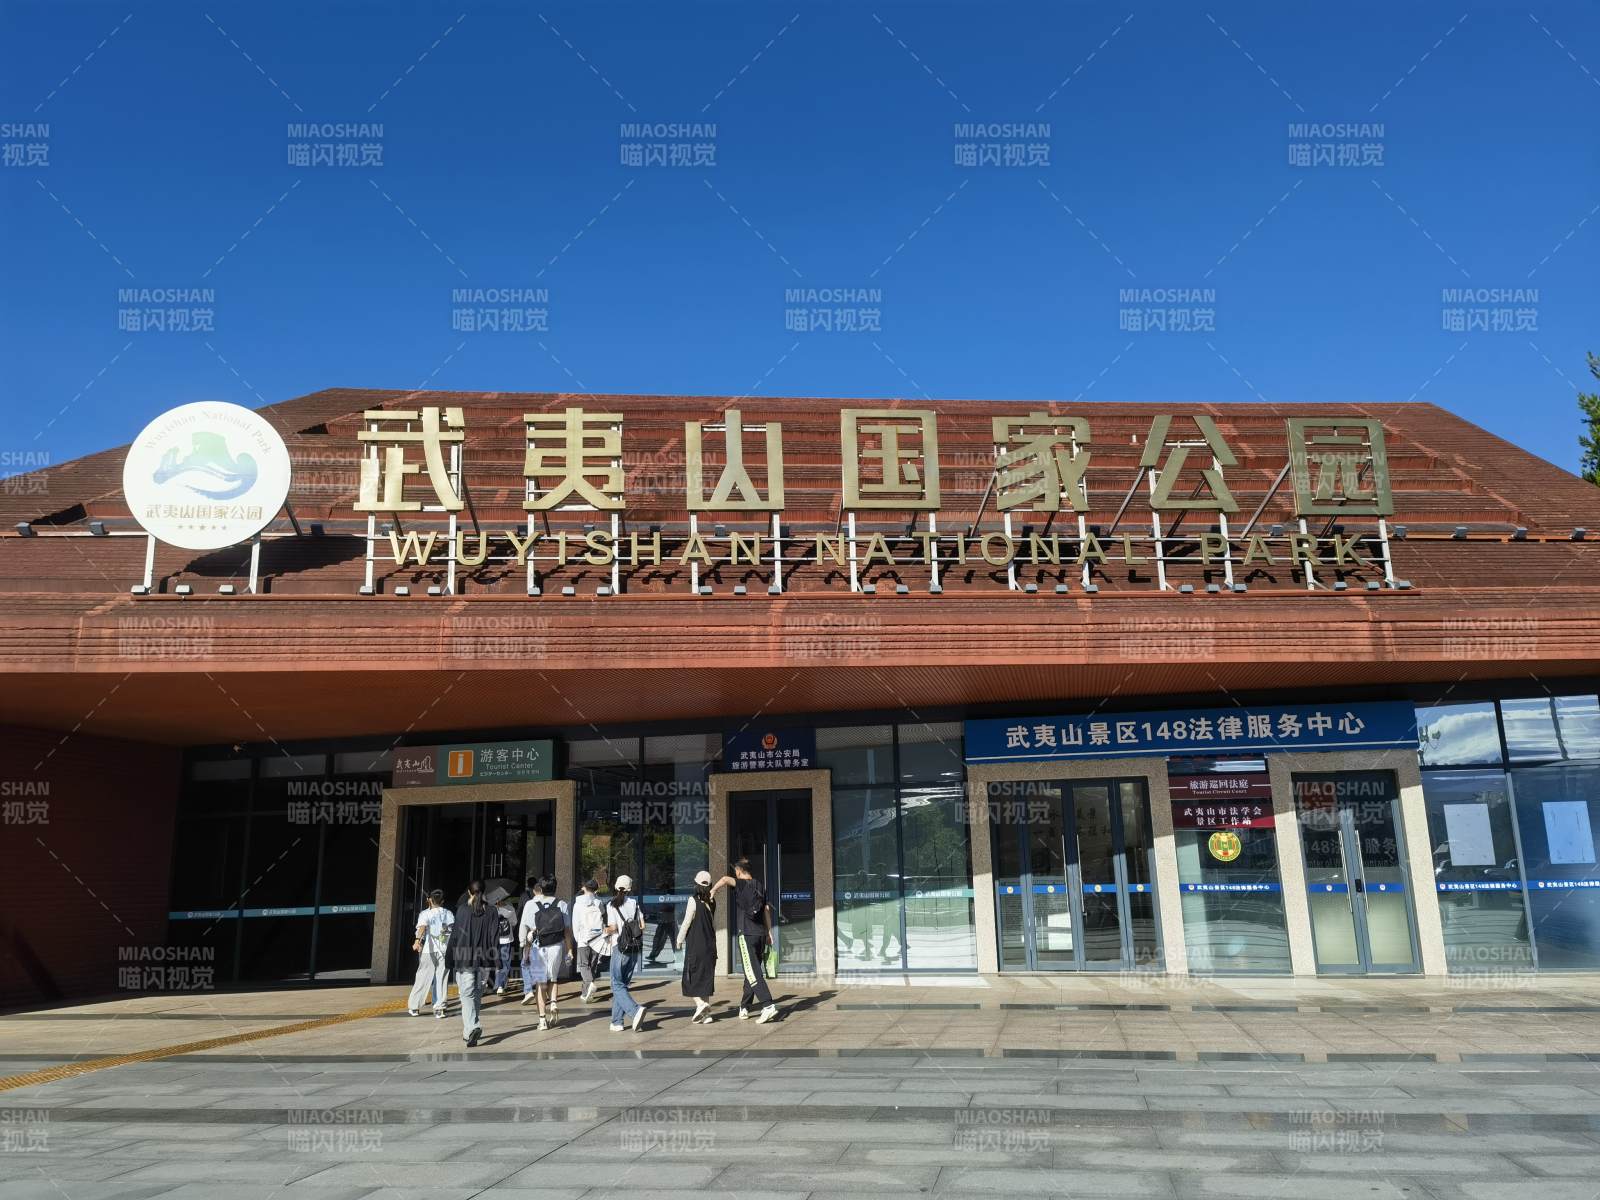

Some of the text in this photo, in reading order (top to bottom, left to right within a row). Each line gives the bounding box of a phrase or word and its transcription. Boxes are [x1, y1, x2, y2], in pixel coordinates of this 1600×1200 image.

[145, 410, 272, 455] Wuyishan National Park
[353, 406, 1394, 516] 武夷山国家公园
[147, 504, 263, 520] 武夷山国家公园
[388, 531, 1367, 566] WUYISHAN NATIONAL PARK
[1006, 712, 1366, 749] 武夷山景区148法律服务中心
[481, 748, 540, 762] 游客中心
[740, 749, 800, 760] 武夷山市公安局
[732, 759, 809, 769] 旅游警察大队警务室
[1190, 779, 1249, 790] 旅游巡回法庭
[1184, 806, 1262, 816] 武夷山市法学会
[1197, 817, 1252, 826] 景区工作站
